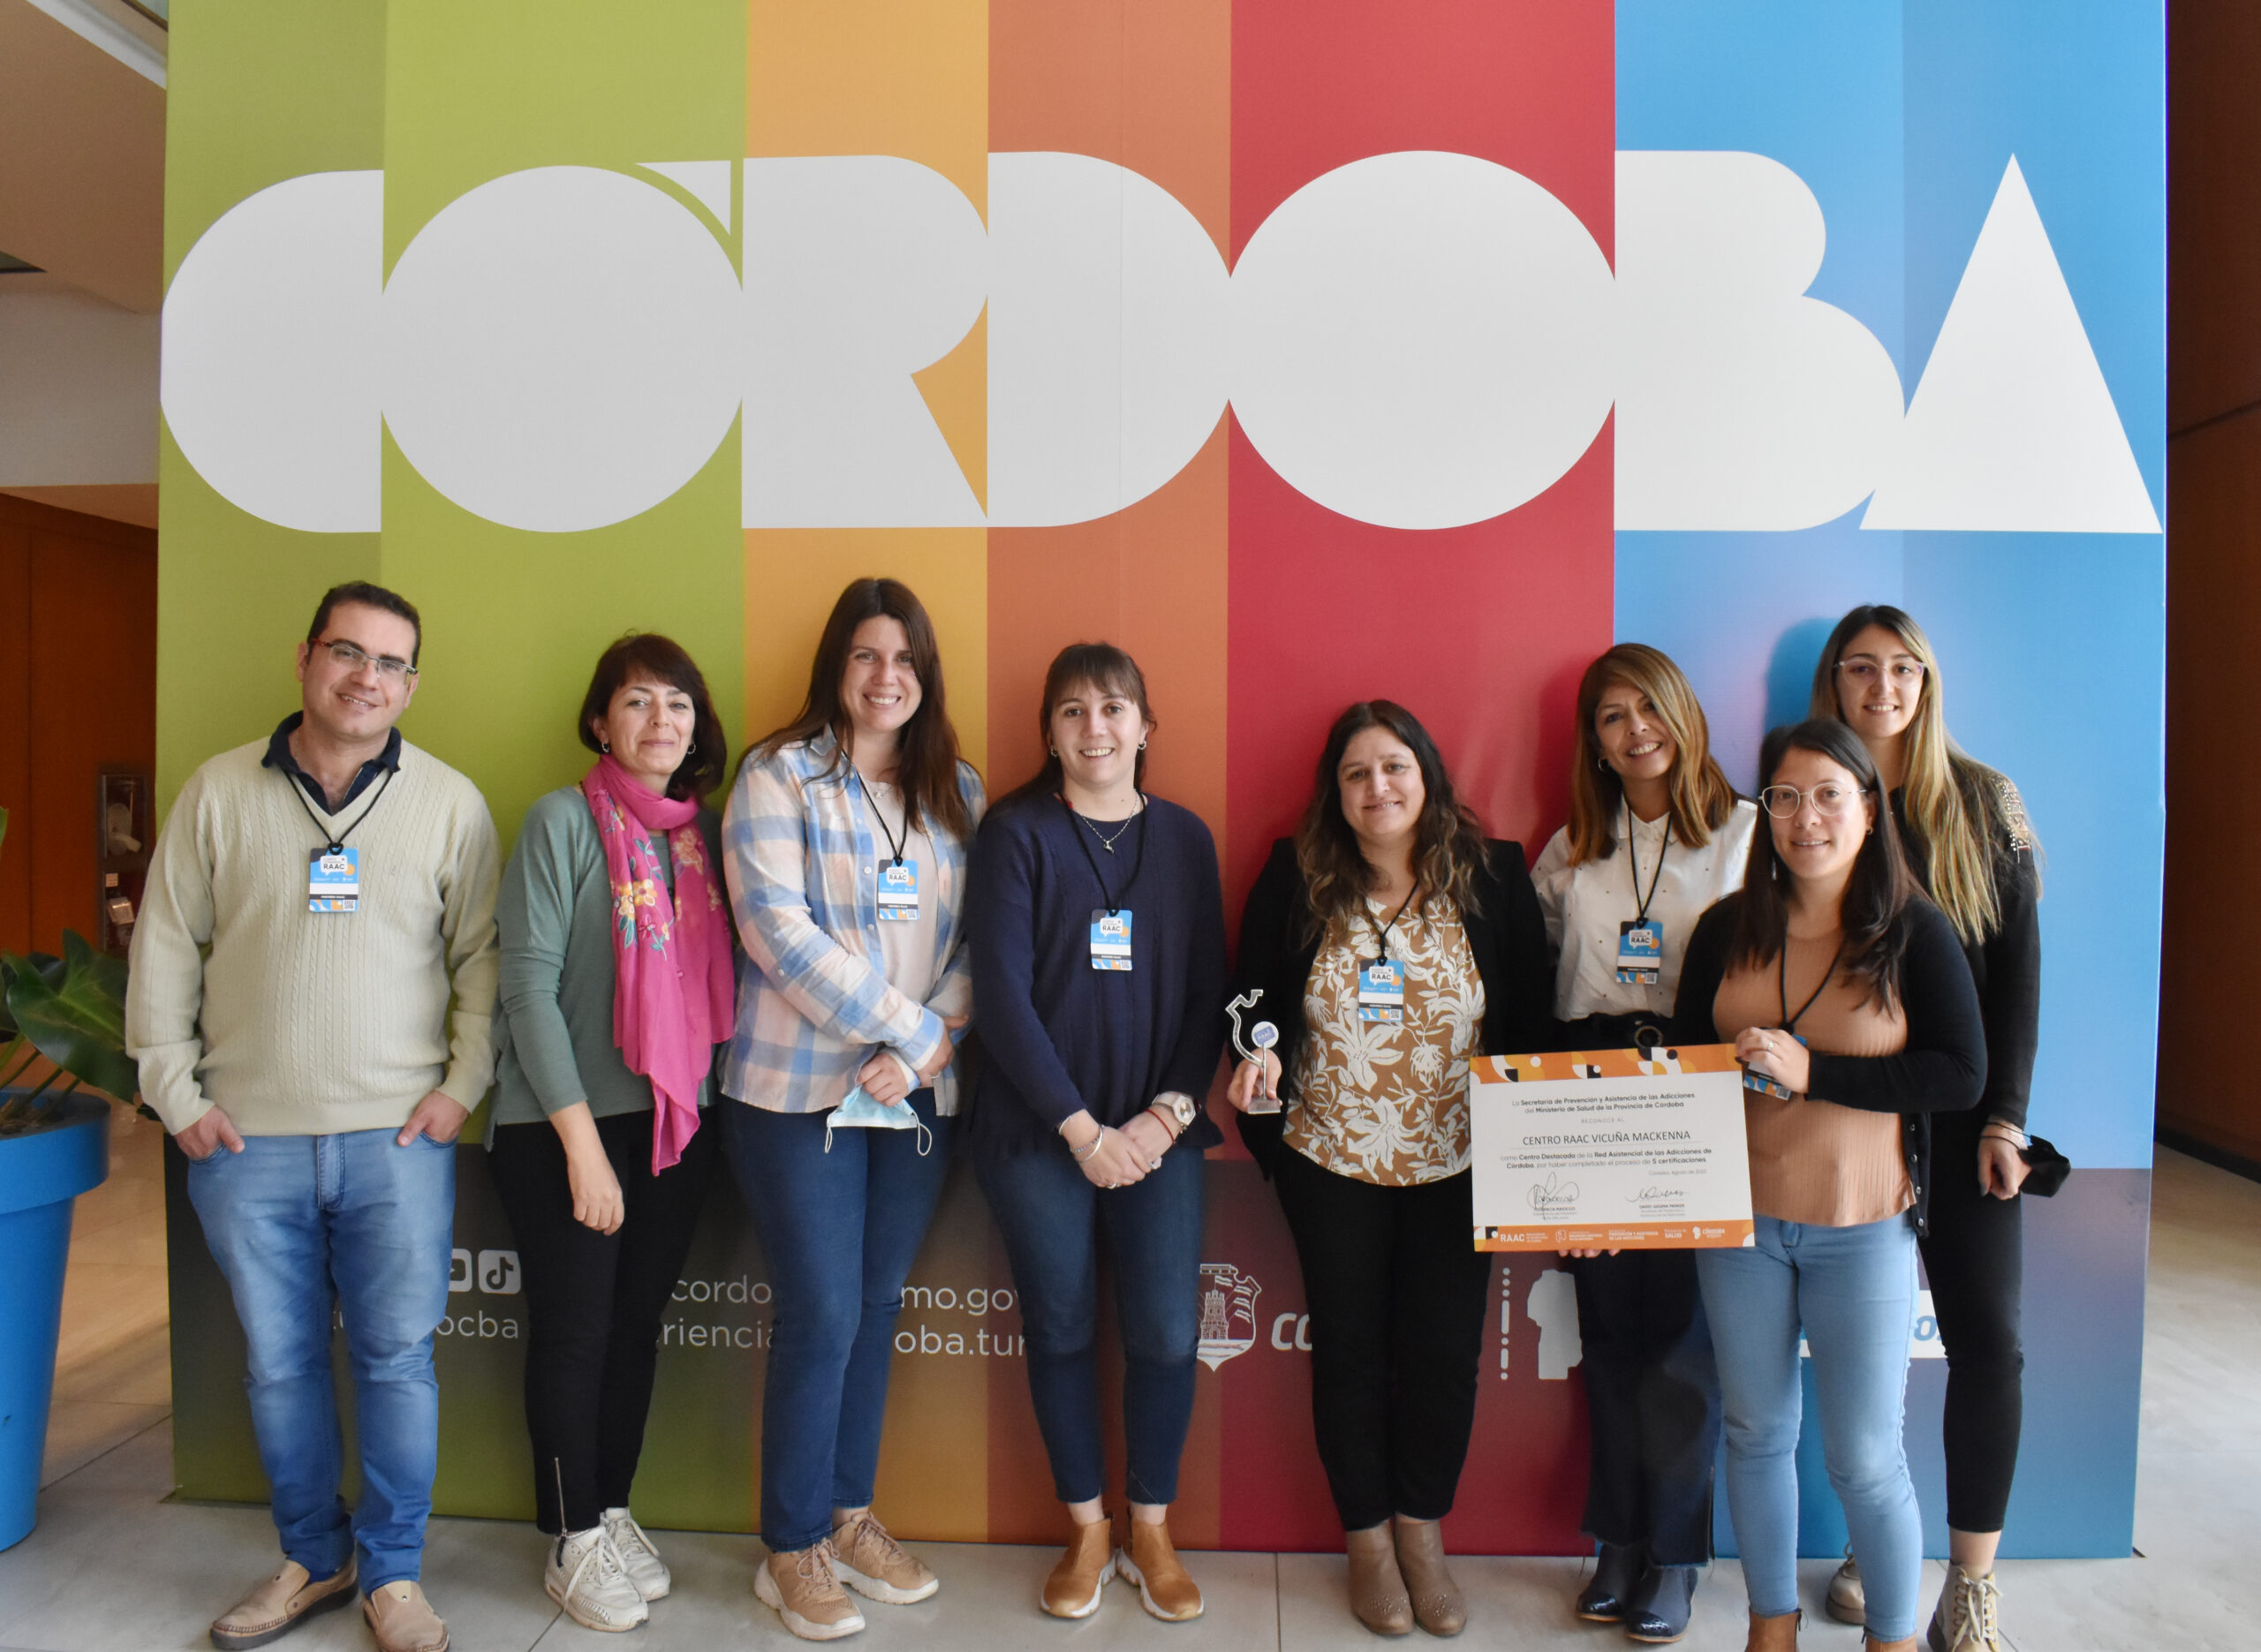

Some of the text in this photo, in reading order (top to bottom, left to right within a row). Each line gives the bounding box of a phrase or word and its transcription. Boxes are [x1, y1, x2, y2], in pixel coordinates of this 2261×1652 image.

[160, 150, 2163, 535] CÓRDOBA
[1523, 1130, 1690, 1145] CENTRO RAAC VICUÑA MACKENNA
[1500, 1233, 1524, 1242] RAAC
